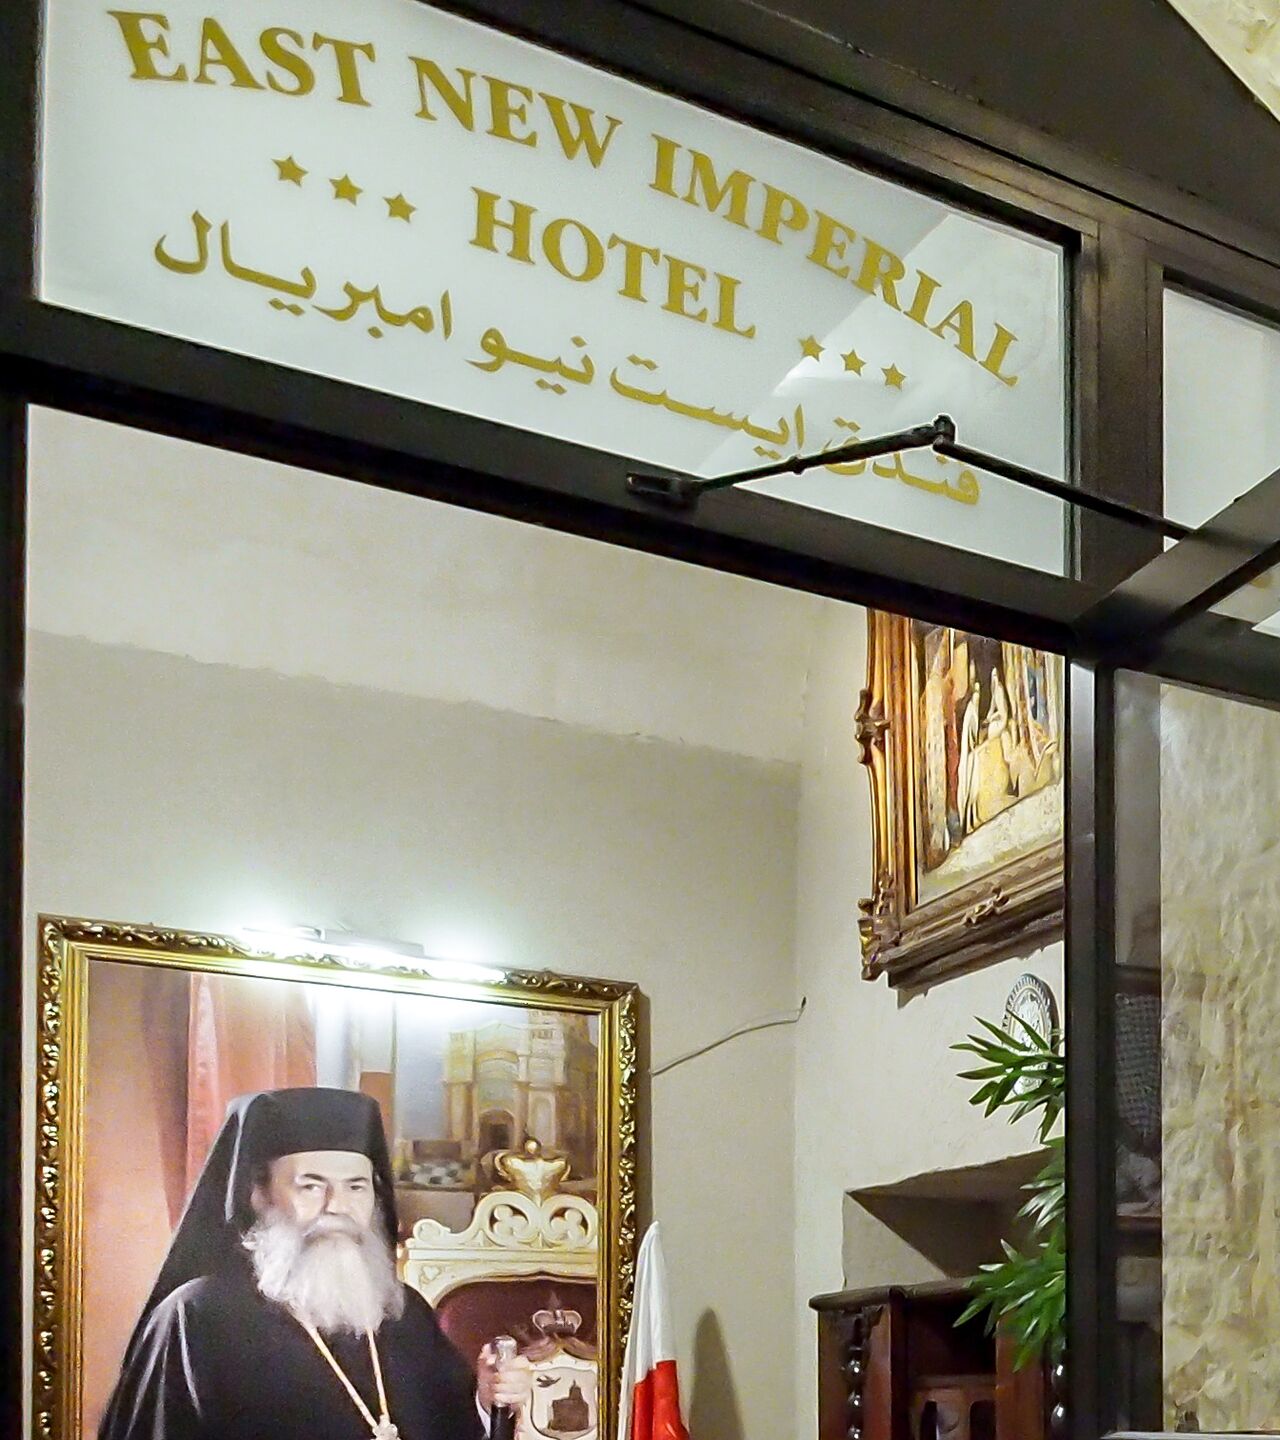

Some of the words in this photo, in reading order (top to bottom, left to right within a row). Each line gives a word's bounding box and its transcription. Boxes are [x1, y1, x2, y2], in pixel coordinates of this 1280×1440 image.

[108, 10, 377, 108] EAST
[412, 56, 622, 169] NEW
[648, 133, 1020, 388] IMPERIAL
[469, 186, 757, 340] HOTEL
[153, 209, 453, 341] امبريال
[464, 335, 596, 396] نيو
[609, 353, 805, 462] ايست
